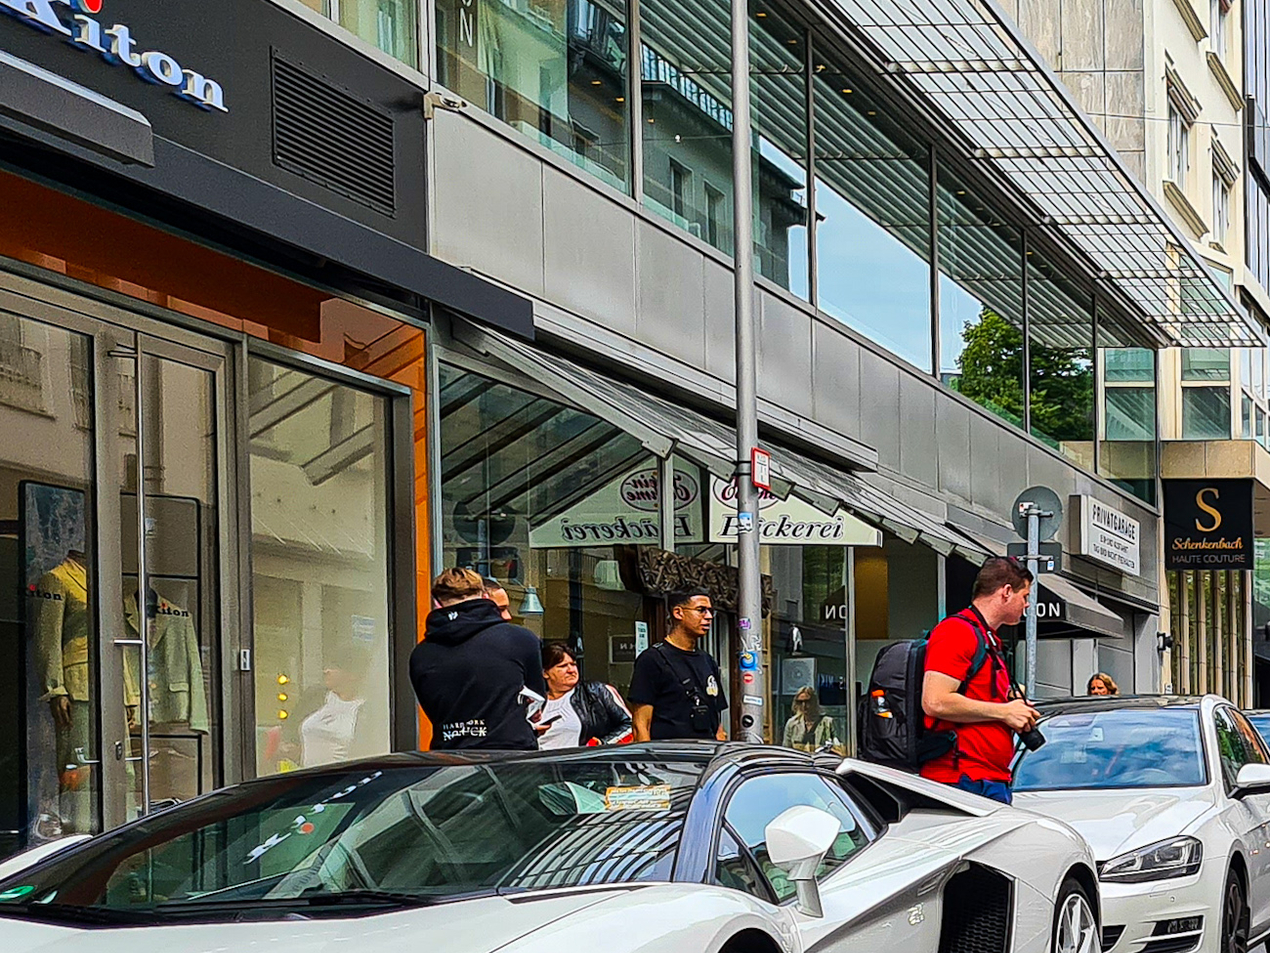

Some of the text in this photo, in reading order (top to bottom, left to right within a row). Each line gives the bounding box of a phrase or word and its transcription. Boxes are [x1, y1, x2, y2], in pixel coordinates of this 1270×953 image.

[1195, 488, 1222, 532] S
[1093, 504, 1135, 540] PRIVATGARAGE
[1172, 537, 1243, 550] Schenkenbach
[1172, 554, 1245, 563] HAUTE COUTURE
[1023, 602, 1060, 618] ON
